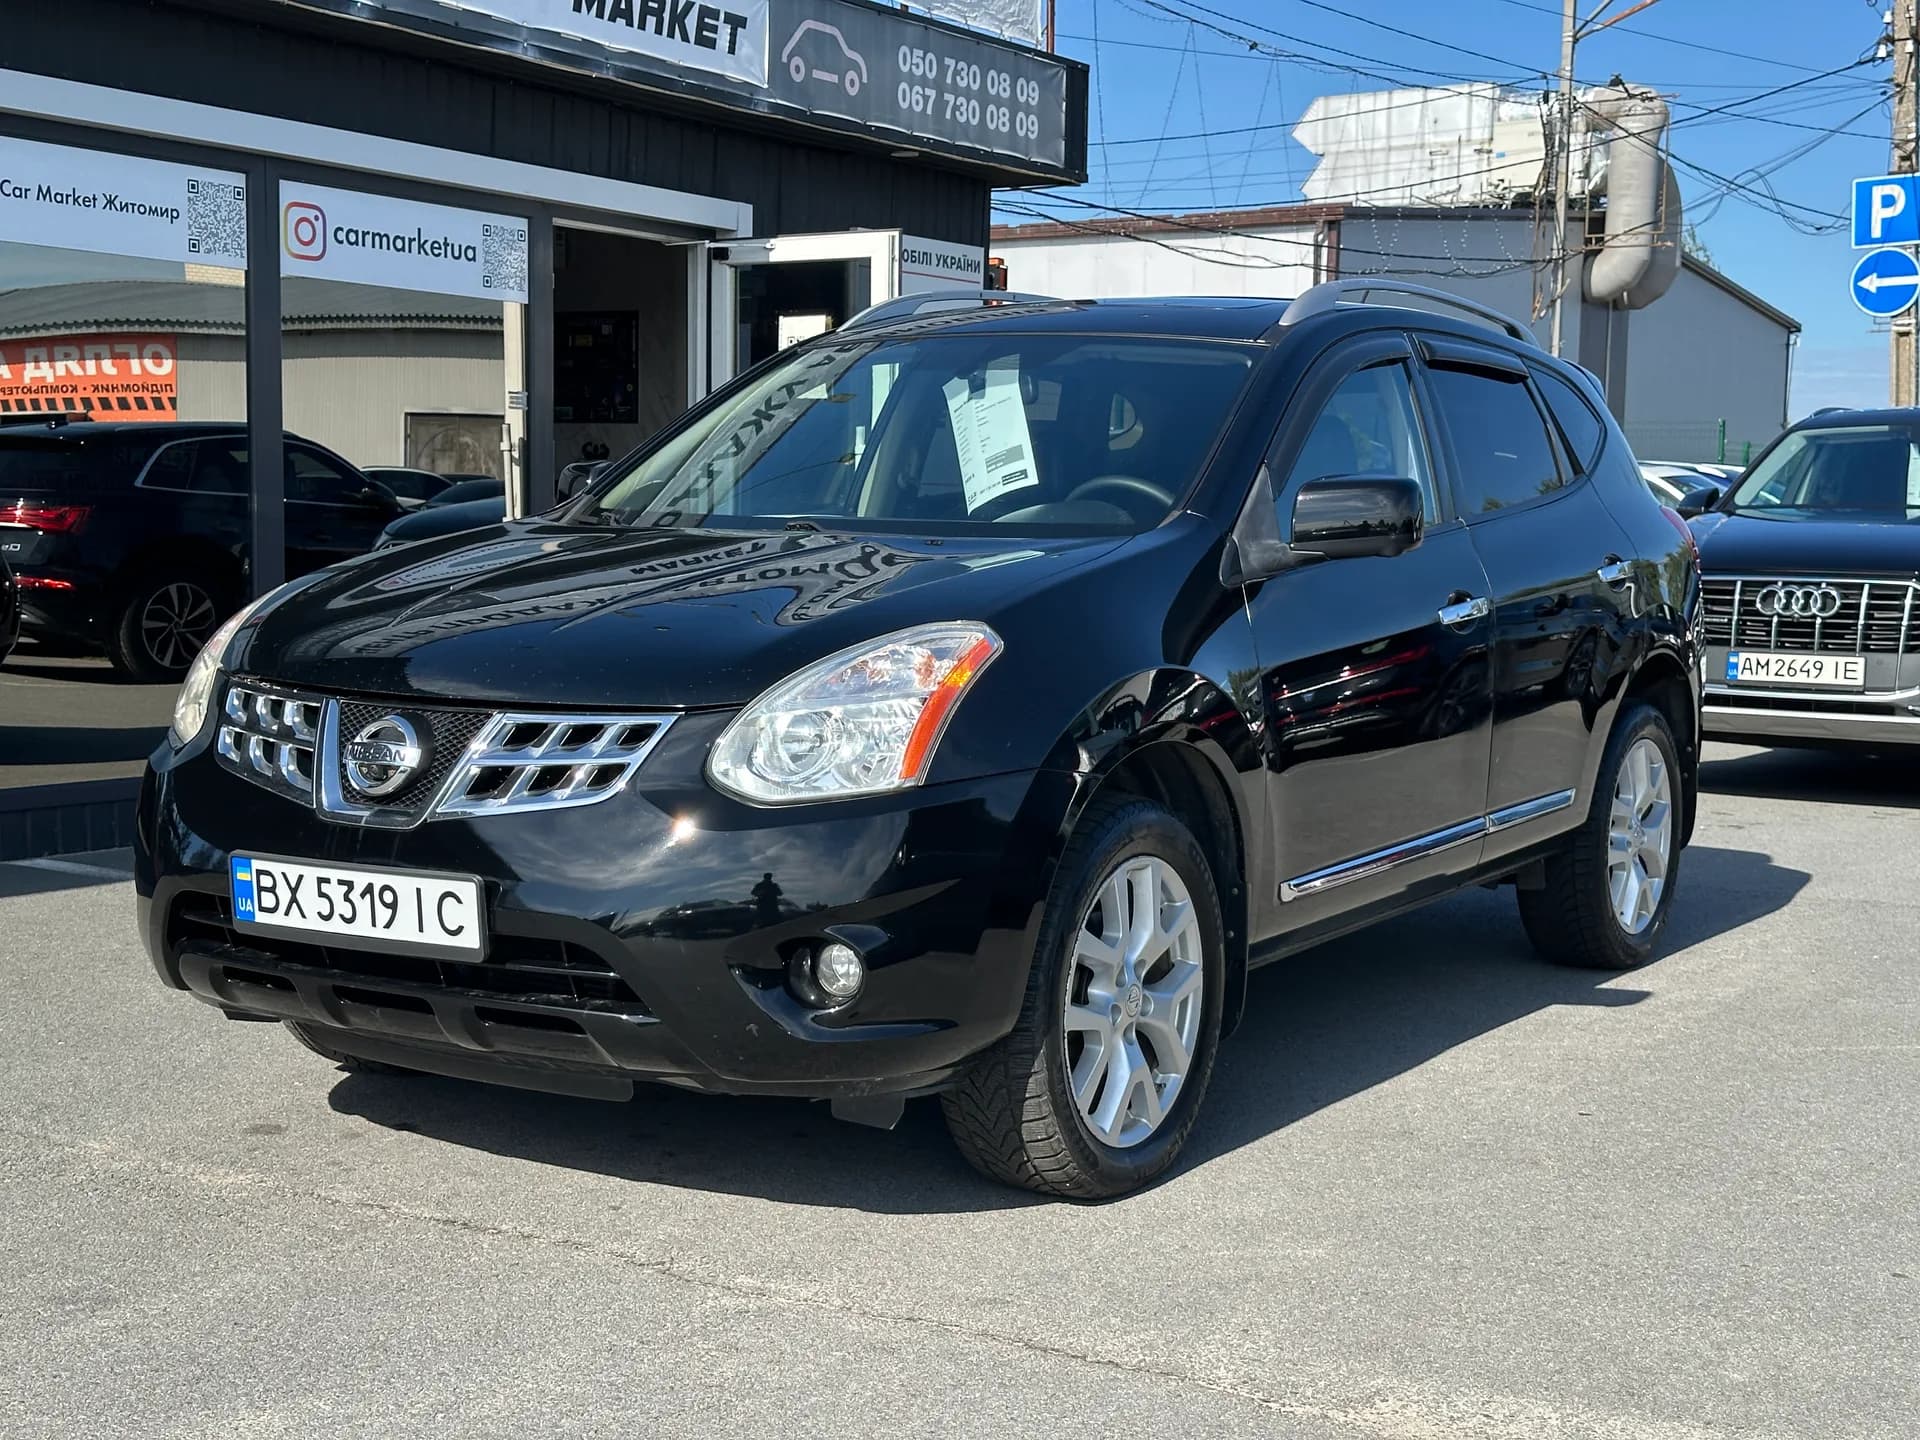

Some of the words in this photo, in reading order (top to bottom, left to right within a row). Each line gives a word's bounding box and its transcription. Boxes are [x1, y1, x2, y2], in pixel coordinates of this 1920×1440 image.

[898, 45, 937, 80] 050
[944, 56, 981, 91] 730
[987, 69, 1011, 98] 08
[1016, 77, 1040, 106] 09
[898, 81, 936, 115] 067
[943, 92, 980, 126] 730
[986, 104, 1010, 133] 08
[1015, 111, 1039, 140] 09
[0, 179, 31, 200] Car
[36, 184, 98, 209] Market
[102, 192, 180, 224] Житомир
[1871, 184, 1906, 239] P
[333, 226, 477, 263] carmarketua
[935, 253, 980, 274] УКРАЇНИ
[1741, 657, 1770, 677] AM
[1774, 658, 1824, 679] 2649
[1835, 661, 1859, 680] IE
[238, 897, 254, 913] UA
[255, 868, 307, 919] BX
[316, 876, 399, 930] 5319
[415, 886, 465, 937] IC
